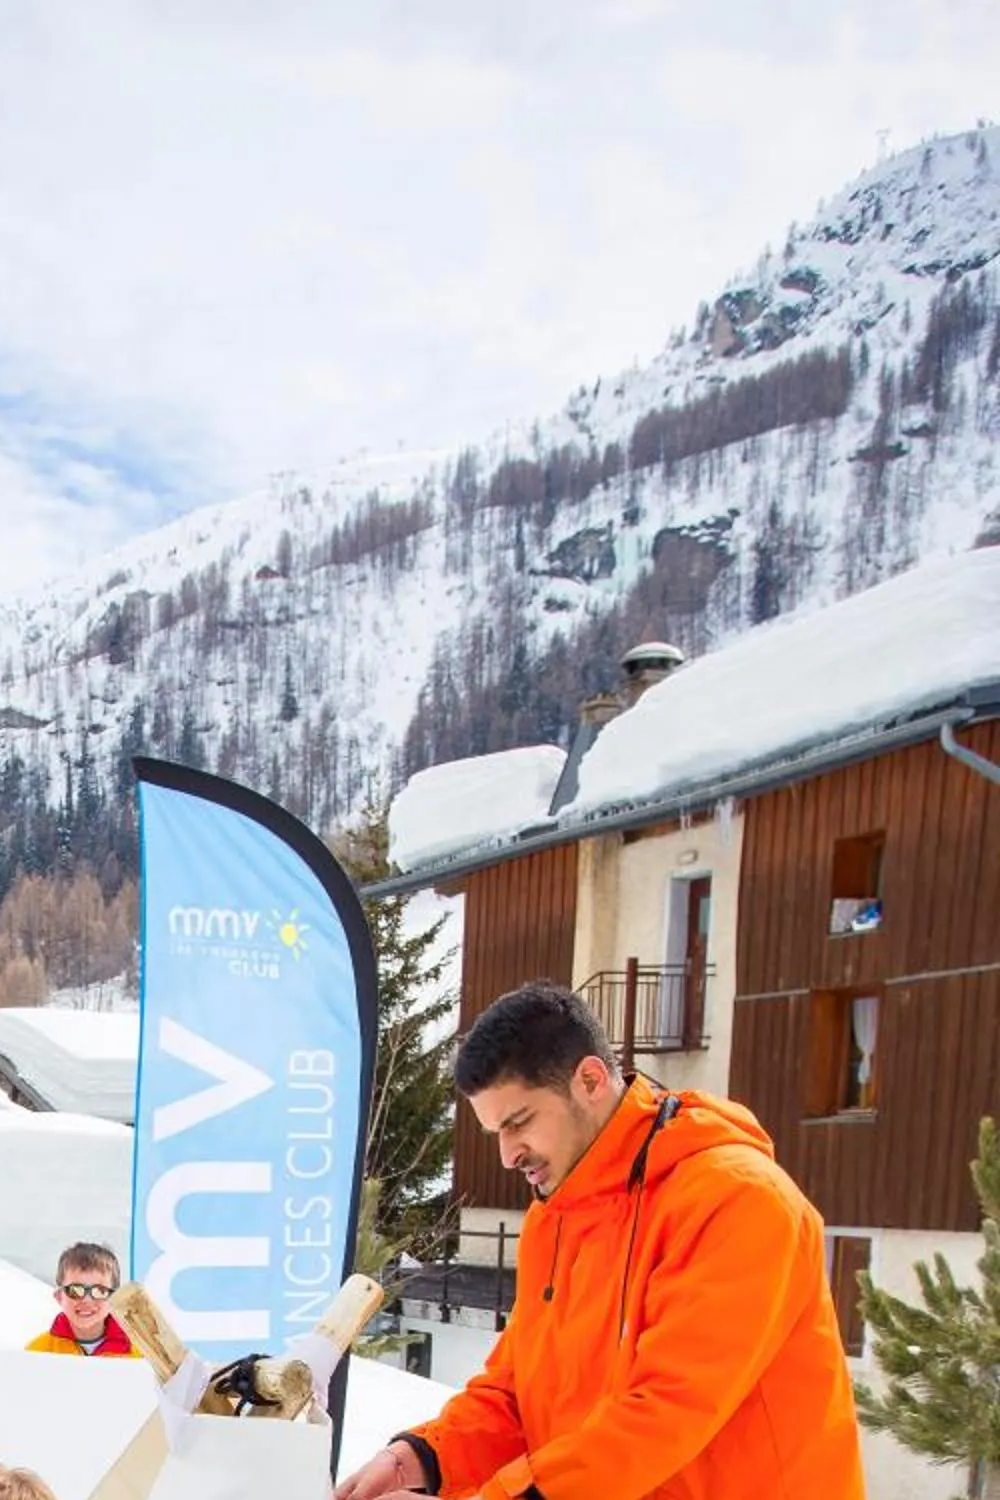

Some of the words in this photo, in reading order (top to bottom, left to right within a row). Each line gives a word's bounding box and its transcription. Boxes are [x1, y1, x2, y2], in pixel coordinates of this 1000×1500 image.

[168, 904, 260, 940] mmv
[228, 960, 281, 980] CLUB
[144, 1015, 275, 1342] mv
[286, 1048, 336, 1179] CLUB
[283, 1196, 333, 1344] NCES
